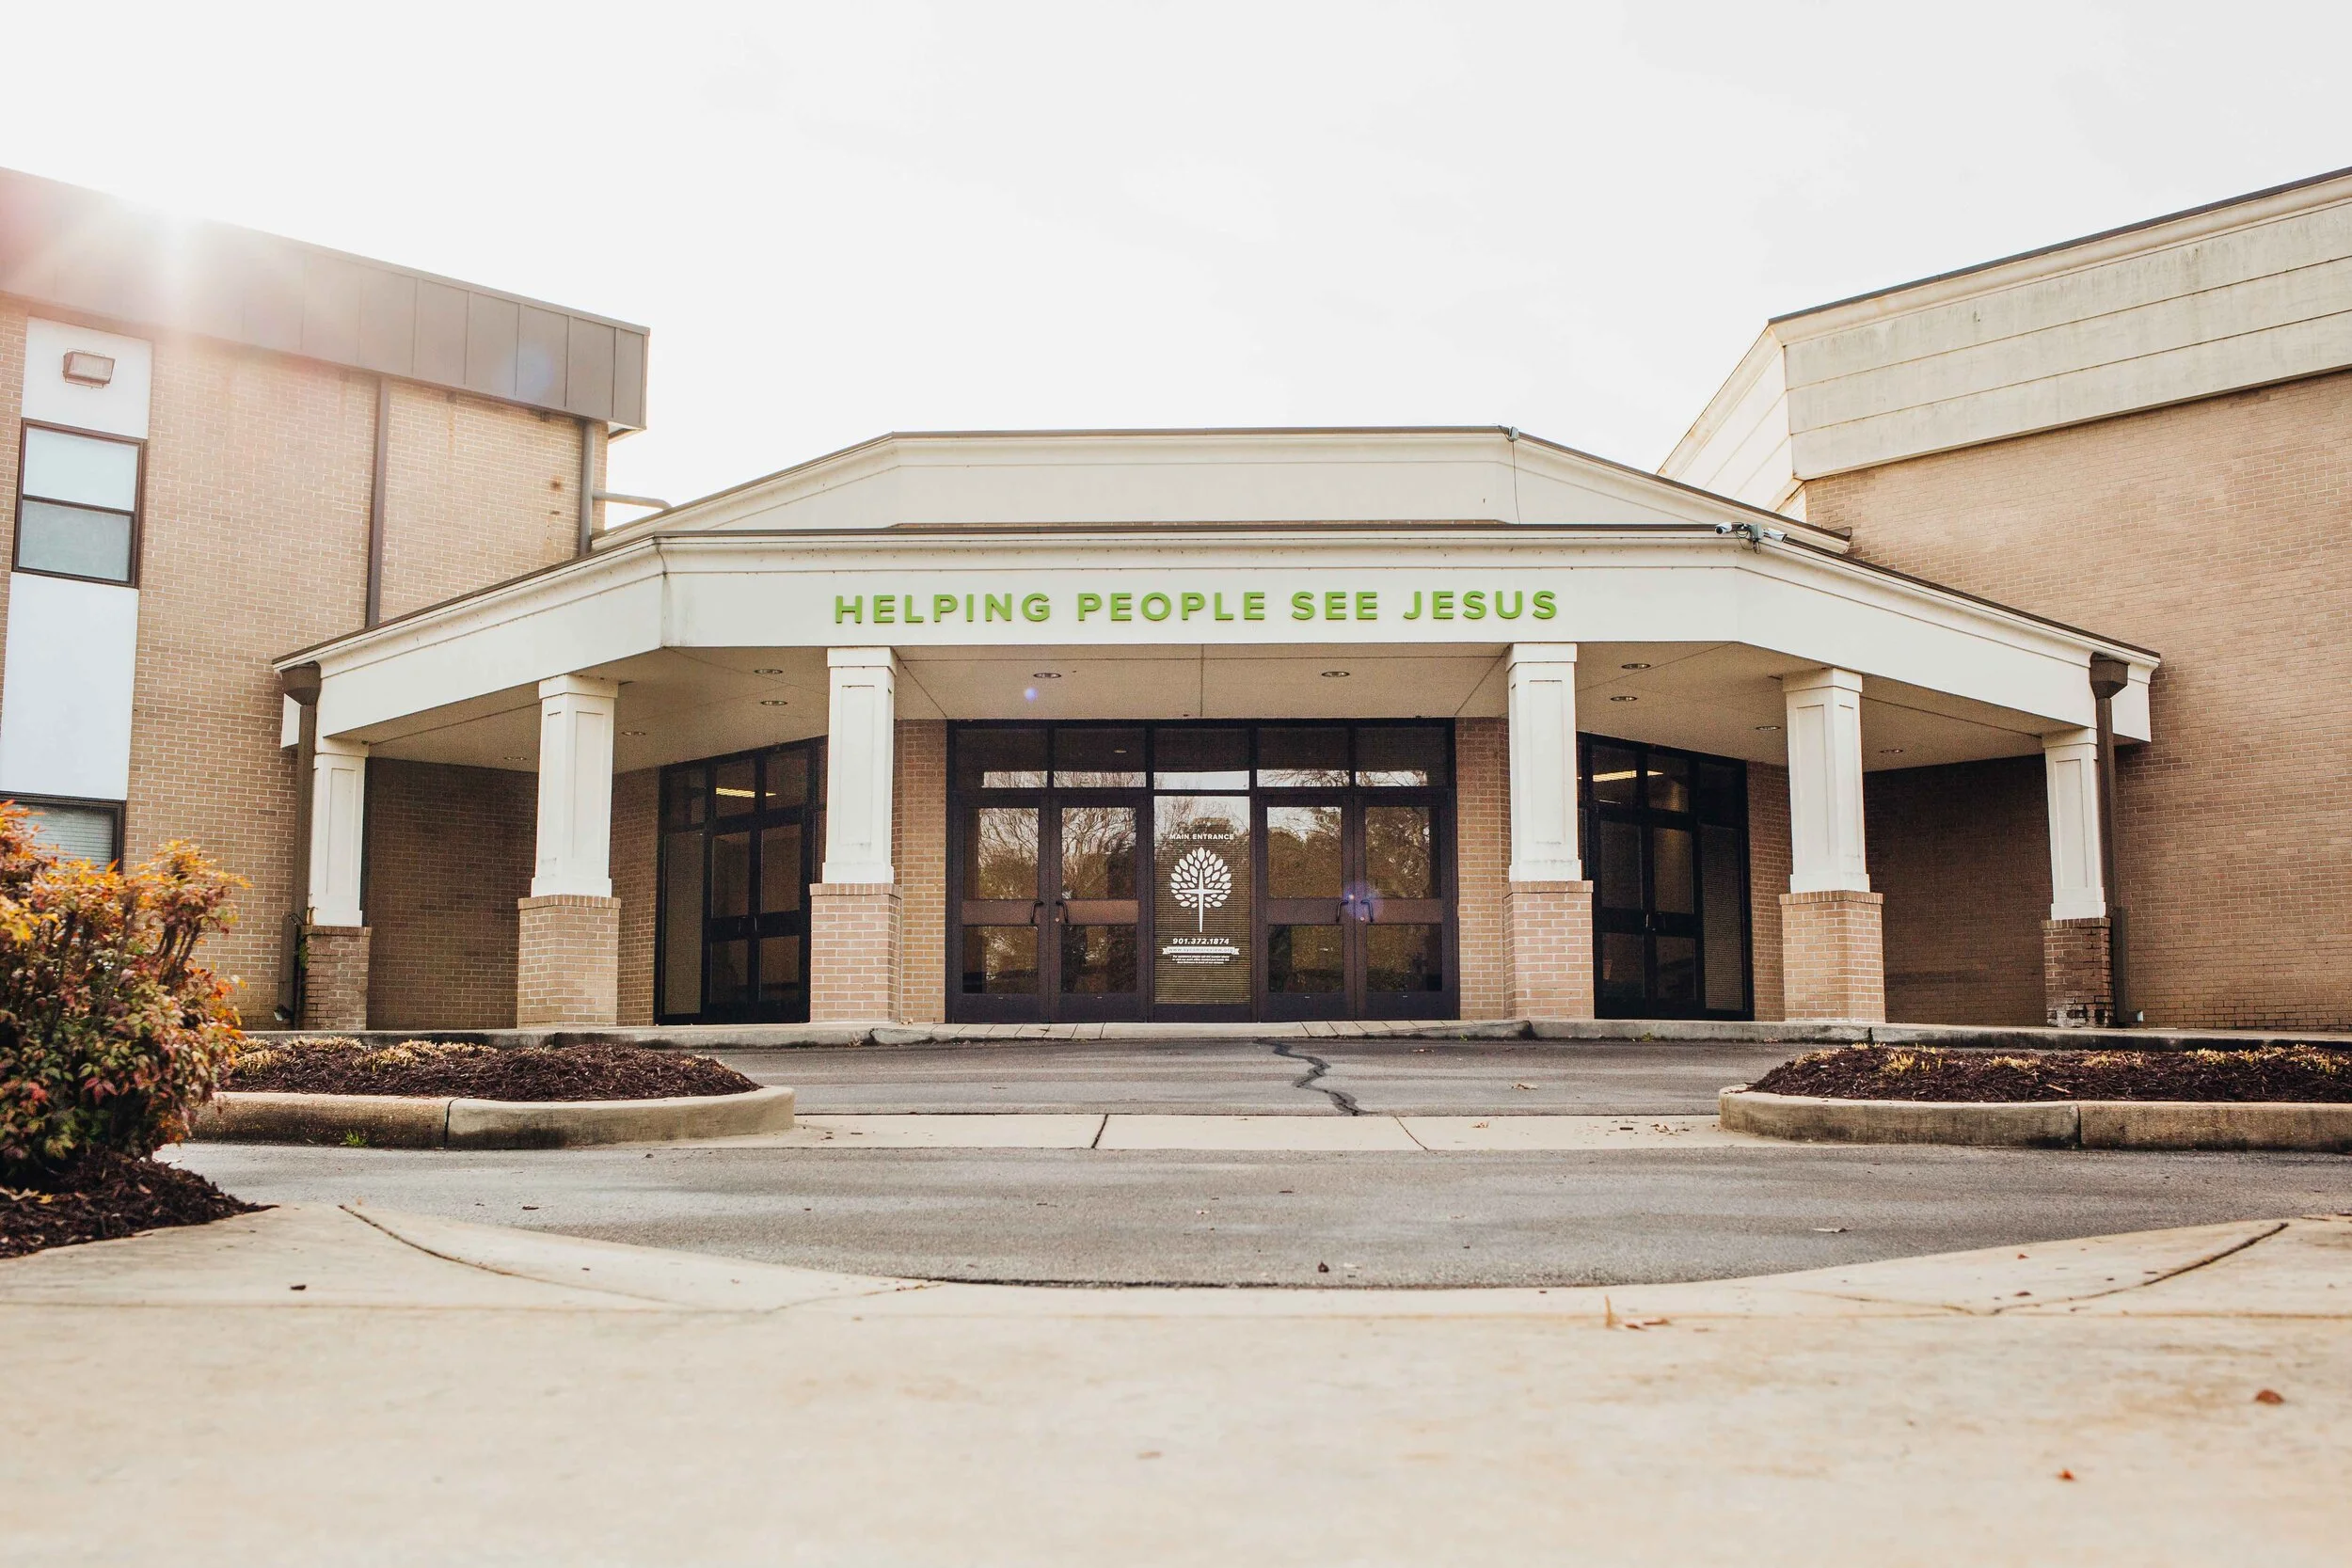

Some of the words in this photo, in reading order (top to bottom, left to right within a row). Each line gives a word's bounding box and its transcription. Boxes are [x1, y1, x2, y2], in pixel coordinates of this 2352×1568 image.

[834, 593, 1051, 625] HELPING
[1076, 591, 1265, 623] PEOPLE
[1291, 591, 1378, 622] SEE
[1403, 590, 1557, 621] JESUS
